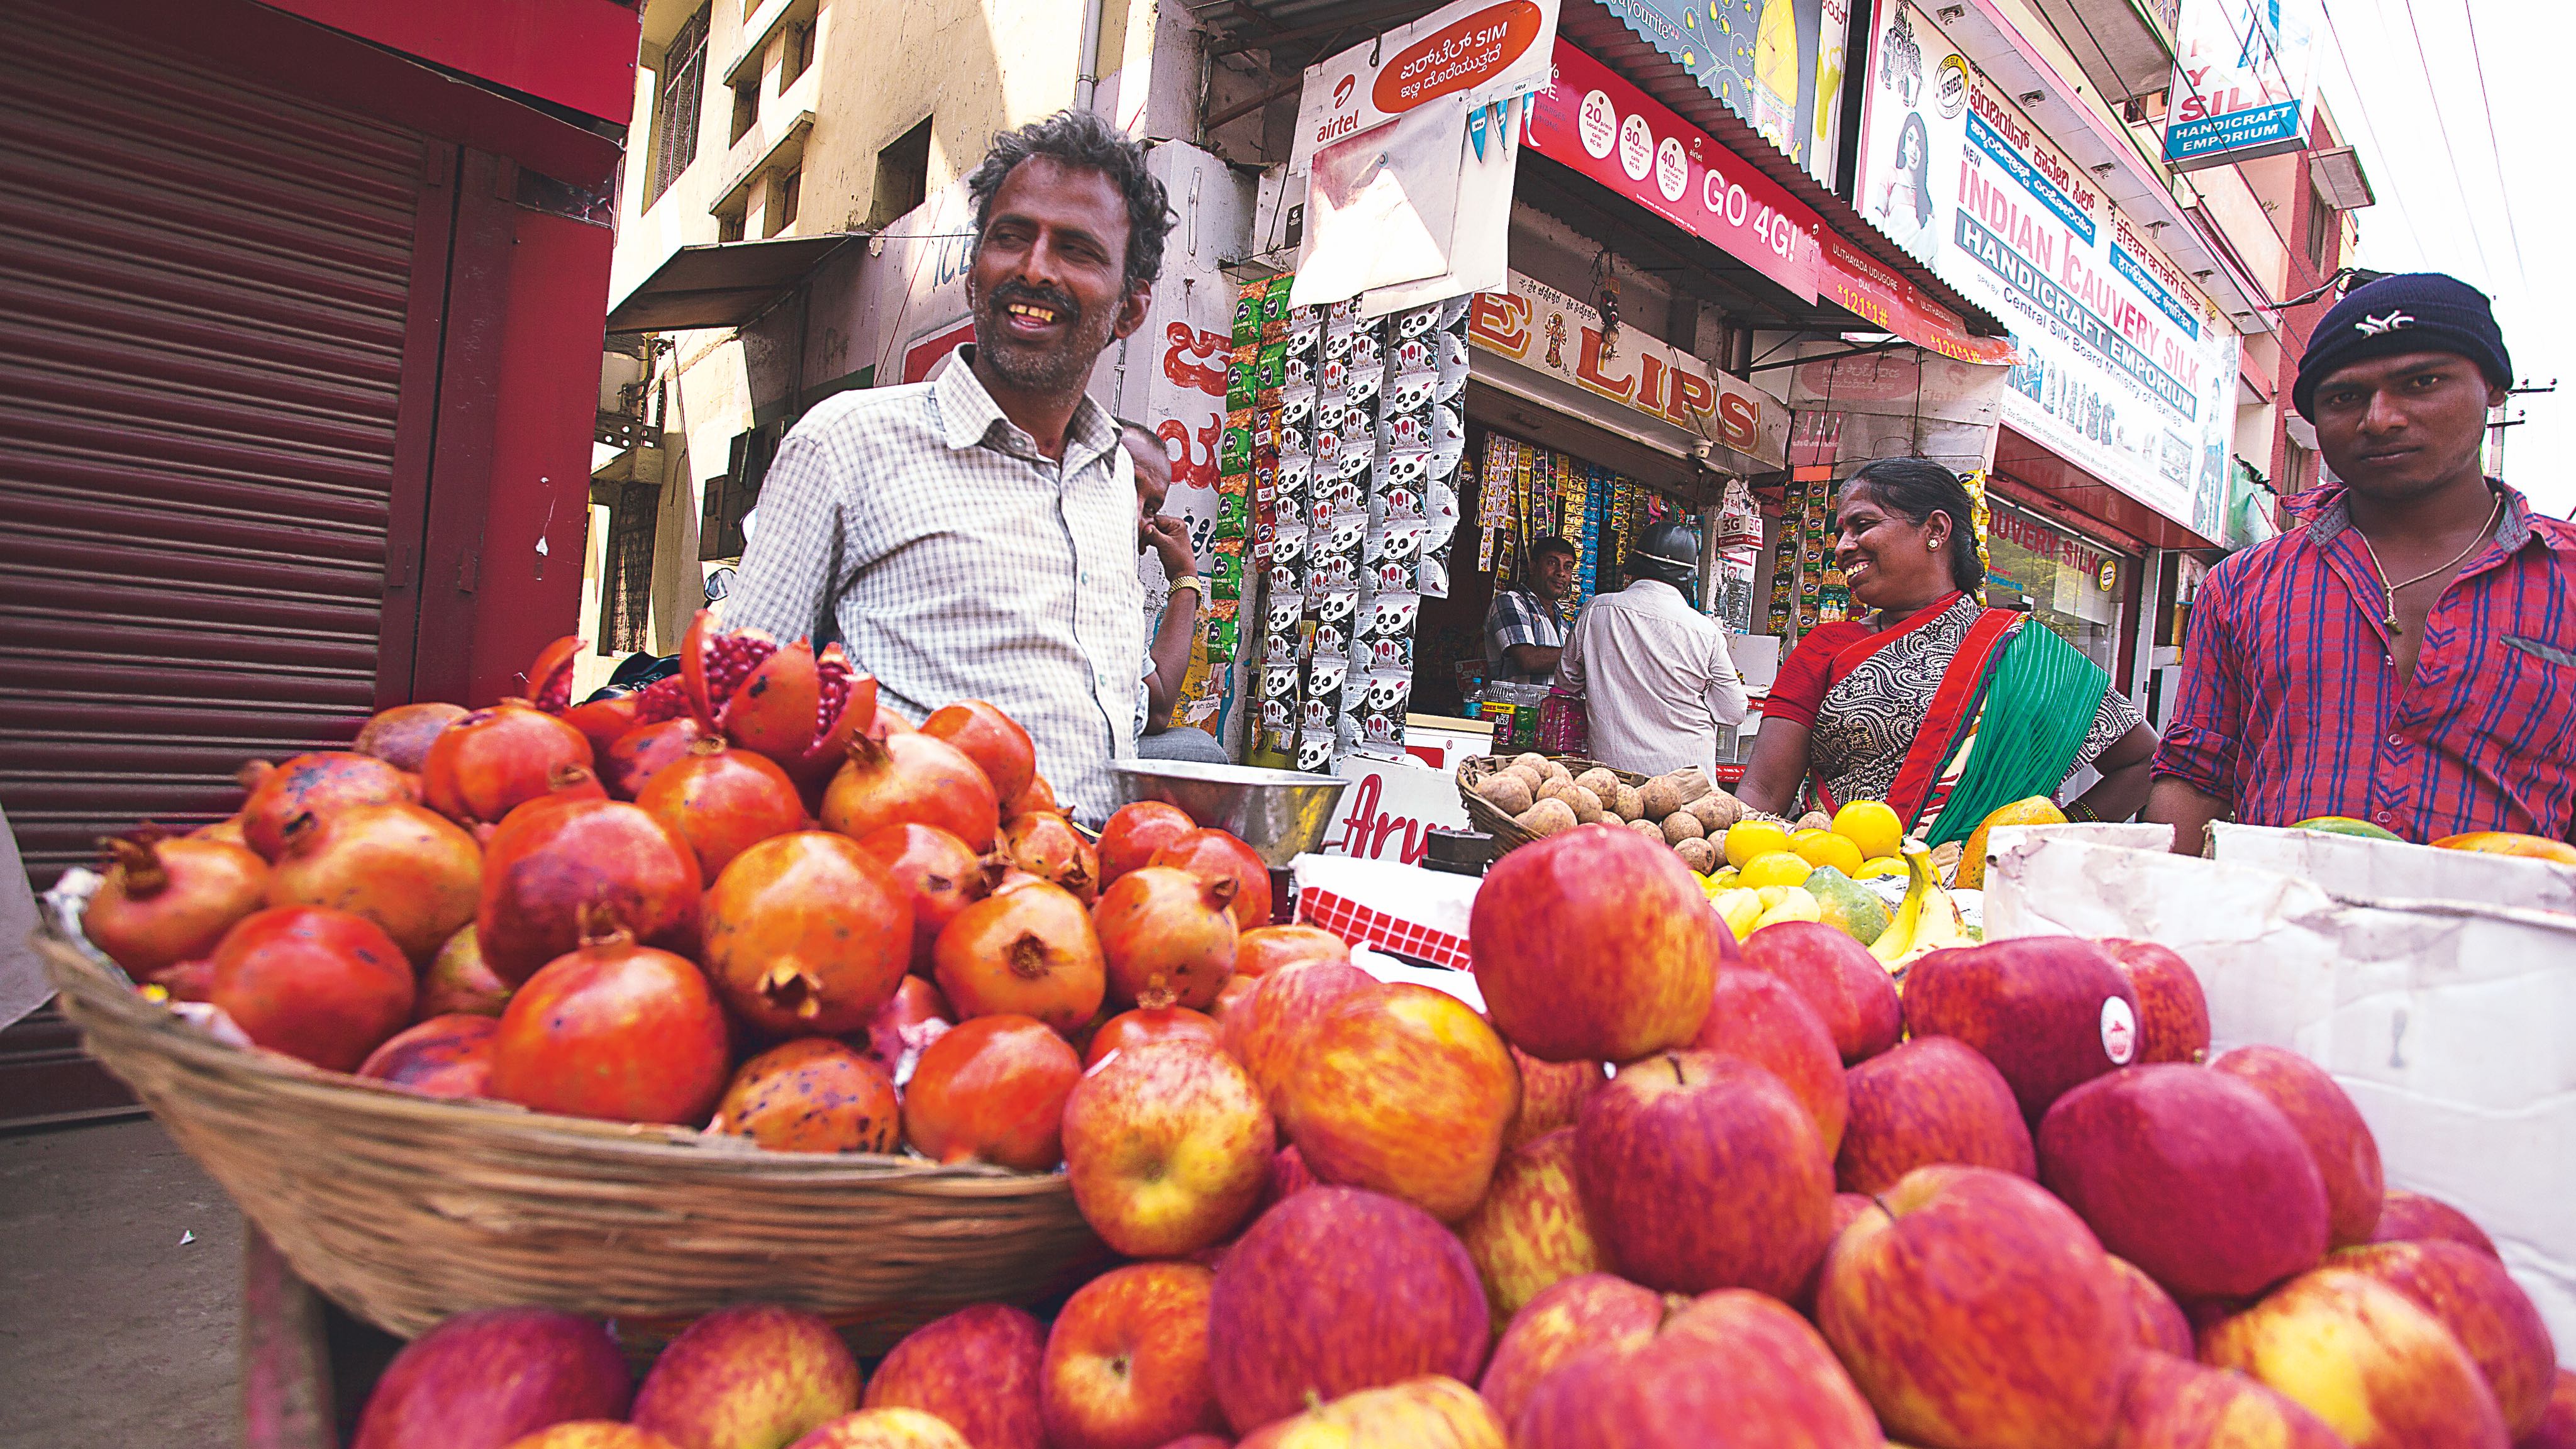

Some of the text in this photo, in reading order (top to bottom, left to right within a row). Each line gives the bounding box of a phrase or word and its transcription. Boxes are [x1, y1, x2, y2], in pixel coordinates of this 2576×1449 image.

[1475, 22, 1507, 47] SIM
[1585, 103, 1601, 123] 20
[2176, 106, 2292, 139] HANDICRAFT
[1317, 110, 1358, 143] airtel
[1586, 121, 1609, 137] Local airtel
[1592, 133, 1601, 141] calls
[1624, 127, 1640, 147] 30
[2183, 124, 2279, 151] EMPORIUM
[1590, 138, 1596, 147] RC
[1963, 143, 1981, 167] NEW
[1661, 151, 1675, 169] 40
[1689, 149, 1702, 162] airtel
[1703, 169, 1797, 262] GO 4G!
[1833, 243, 1897, 291] ULITHAYADA UDUGORE
[1958, 160, 2052, 272] INDIAN
[2163, 338, 2199, 392] SILK
[1858, 278, 1872, 292] DIAL
[1962, 220, 2106, 347] HANDICRAFT
[2110, 336, 2195, 419] EMPORIUM
[2004, 287, 2046, 328] Central
[2050, 320, 2069, 345] Silk
[2073, 338, 2102, 368] Board
[2105, 362, 2141, 398] Ministry
[2153, 397, 2182, 427] Textiles
[1576, 325, 1762, 455] LIPS
[1723, 518, 1740, 532] 3G
[1749, 518, 1760, 532] 3G
[1987, 506, 2099, 577] AUVERY SILK
[1341, 774, 1468, 867] Aru
